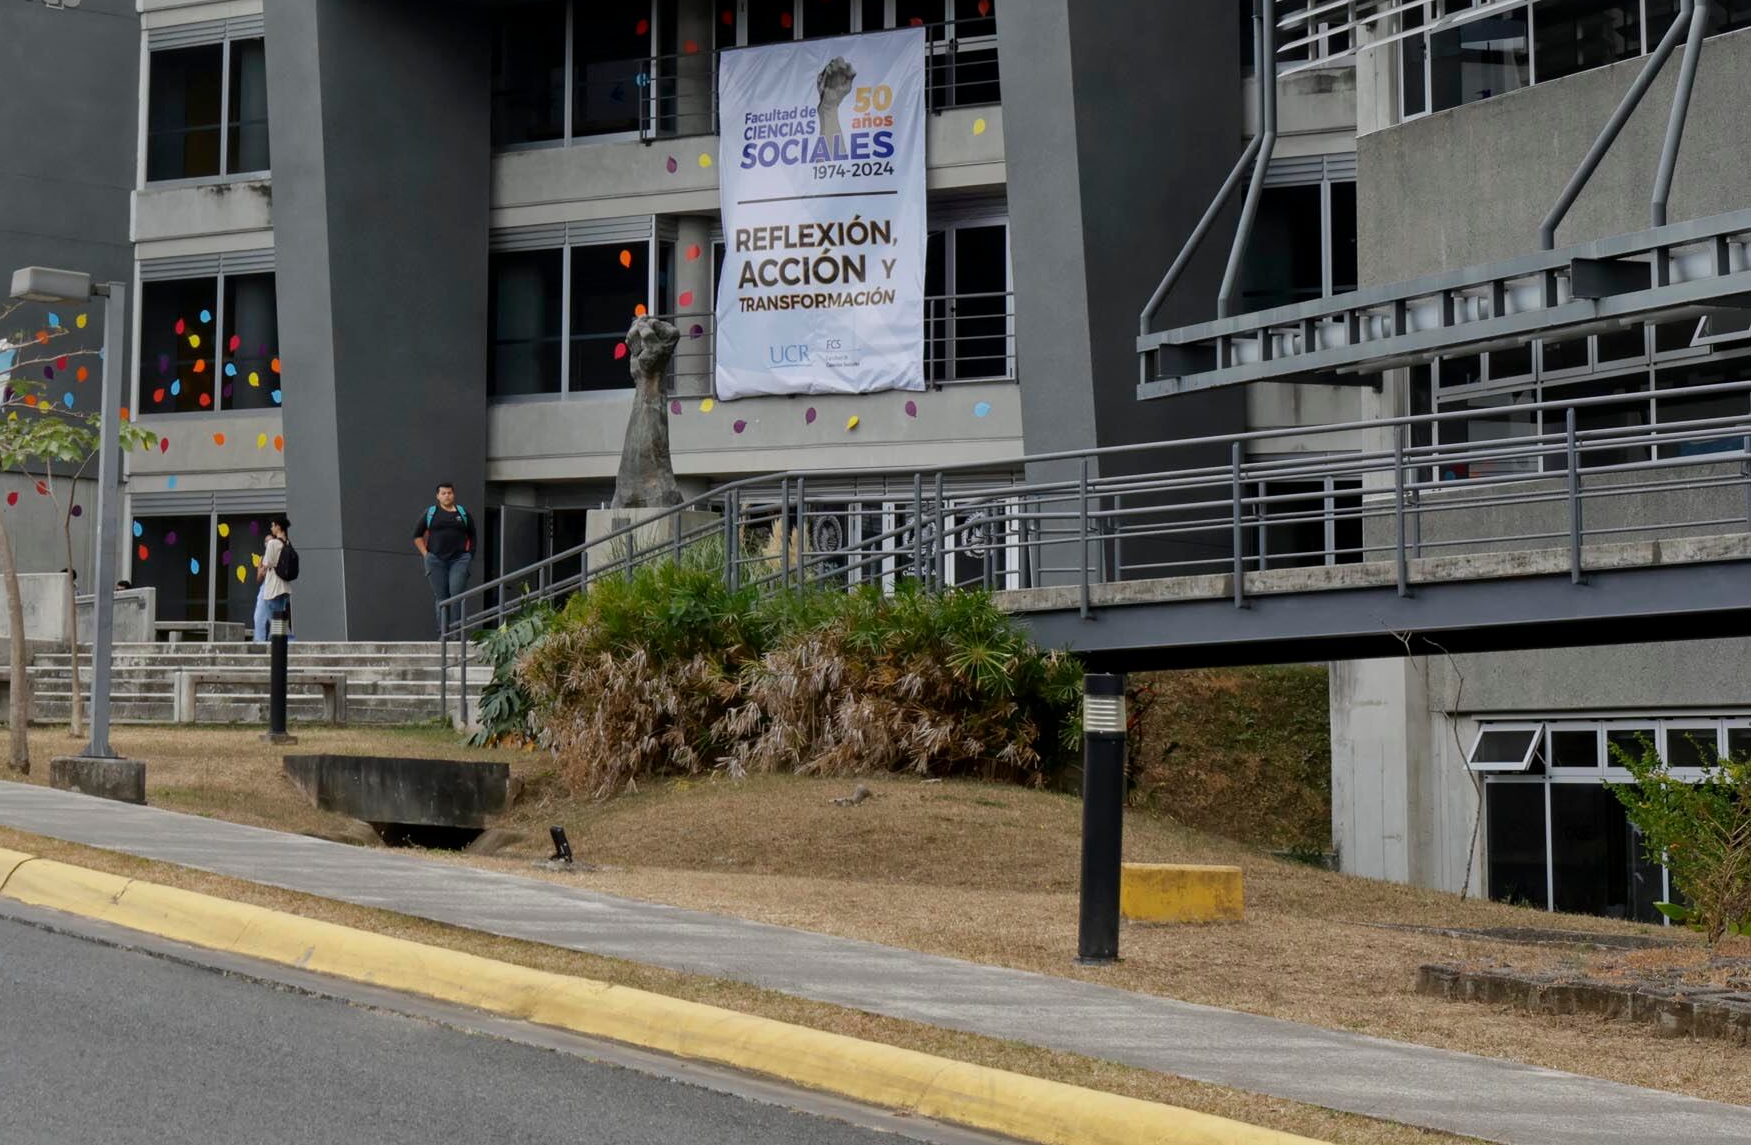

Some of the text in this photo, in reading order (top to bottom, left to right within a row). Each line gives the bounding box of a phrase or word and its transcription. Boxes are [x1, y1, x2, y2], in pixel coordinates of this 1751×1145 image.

[853, 84, 893, 113] 50
[745, 106, 816, 124] Facultad de
[852, 113, 893, 129] años
[744, 120, 815, 141] CIENCIAS
[740, 131, 894, 169] SOCIALES
[813, 161, 894, 179] 1974-2024
[735, 214, 897, 252] REFLEXIÓN,
[738, 248, 897, 289] ACCIÓN Y
[739, 286, 895, 312] TRANSFORMACIÓN
[769, 344, 809, 364] UCR
[826, 339, 841, 350] FCS
